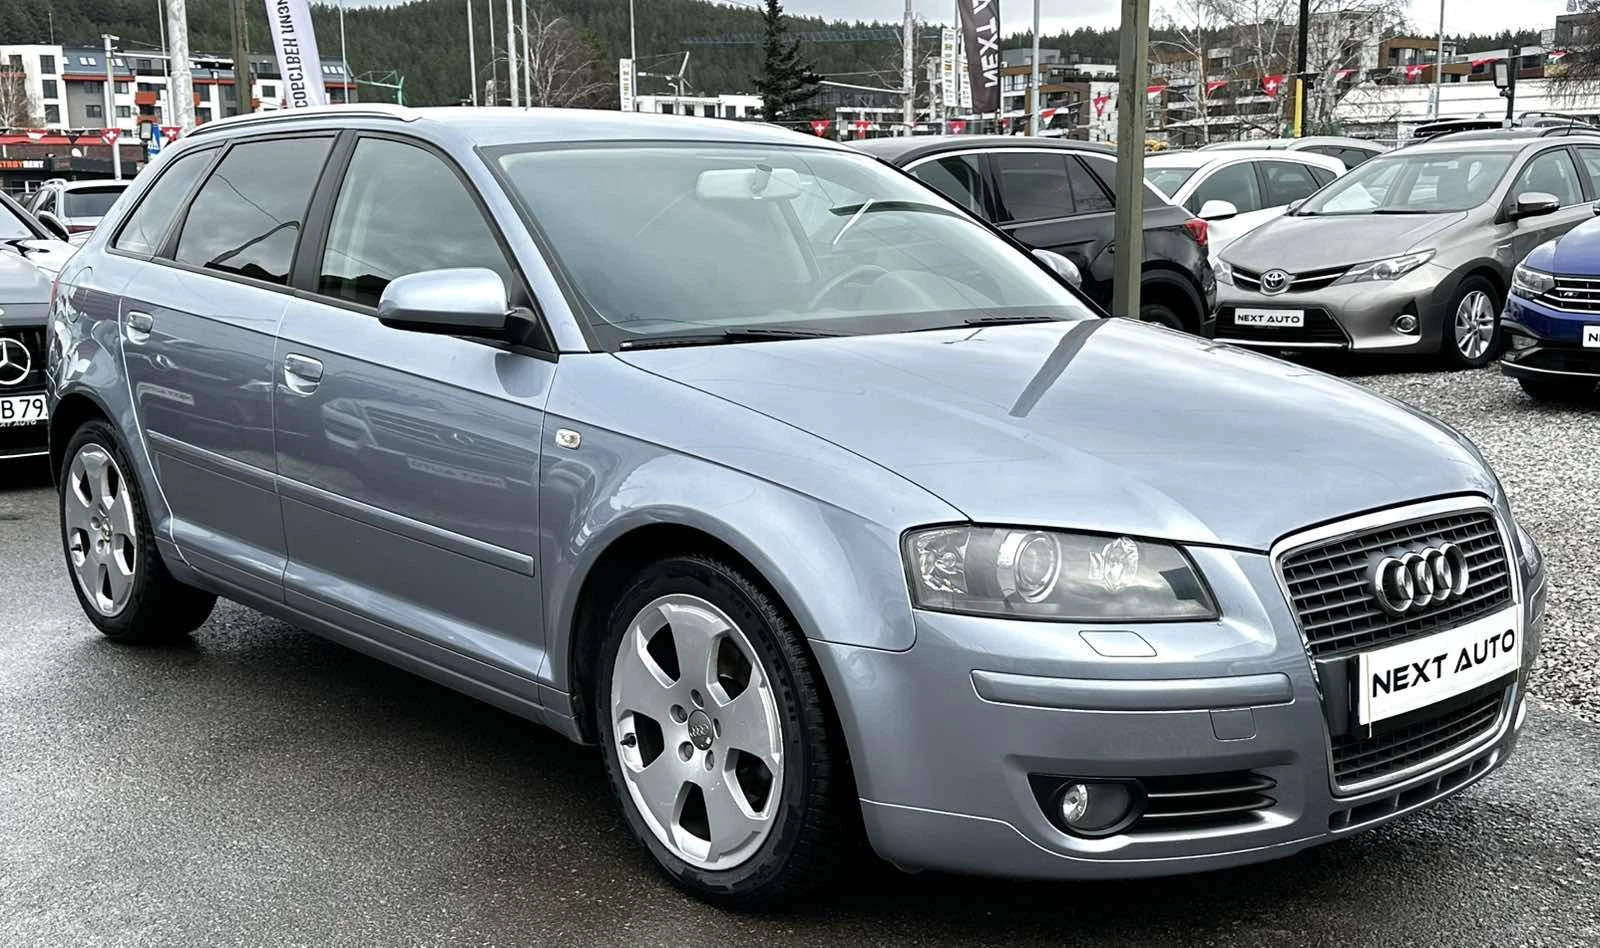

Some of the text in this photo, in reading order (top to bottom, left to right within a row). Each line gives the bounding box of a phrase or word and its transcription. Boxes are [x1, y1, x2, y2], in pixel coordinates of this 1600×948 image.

[1237, 314, 1300, 324] NEXT AUTO
[1588, 333, 1600, 342] N
[19, 398, 48, 418] 79
[1372, 628, 1516, 698] NEXT AUTO
